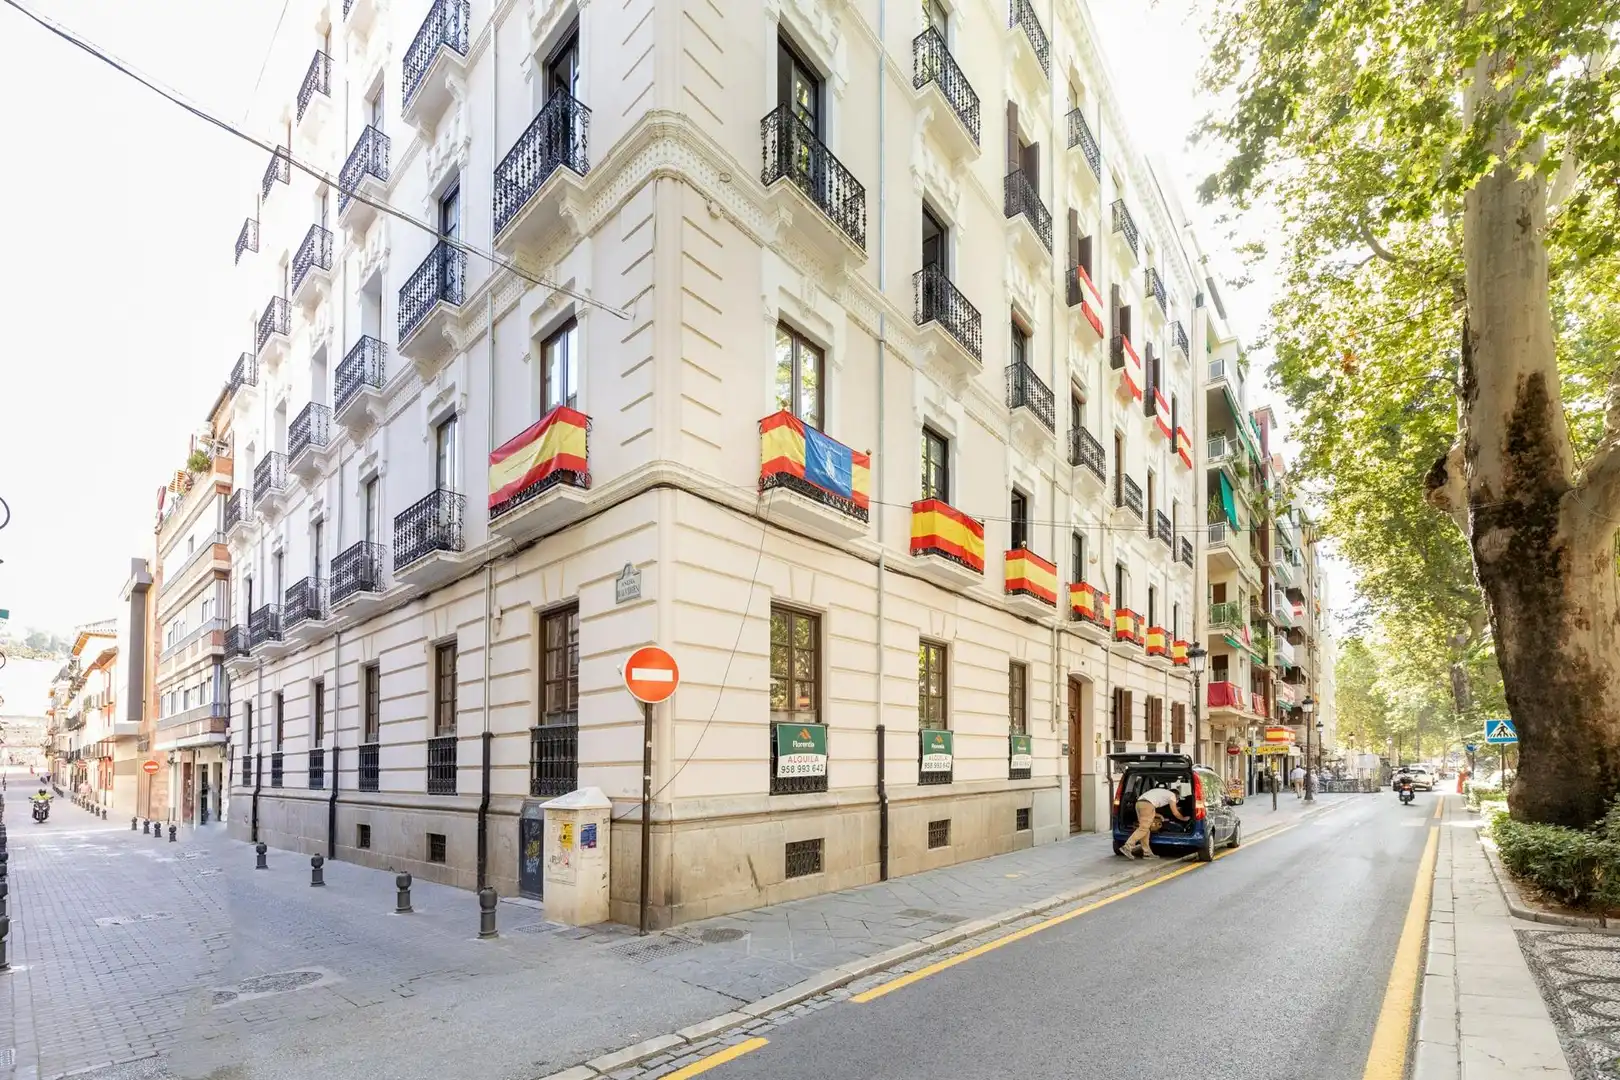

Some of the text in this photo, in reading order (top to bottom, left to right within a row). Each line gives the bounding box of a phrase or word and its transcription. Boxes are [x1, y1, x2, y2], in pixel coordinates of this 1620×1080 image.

[788, 755, 819, 764] ALQUILA
[781, 764, 824, 774] 958 993 642
